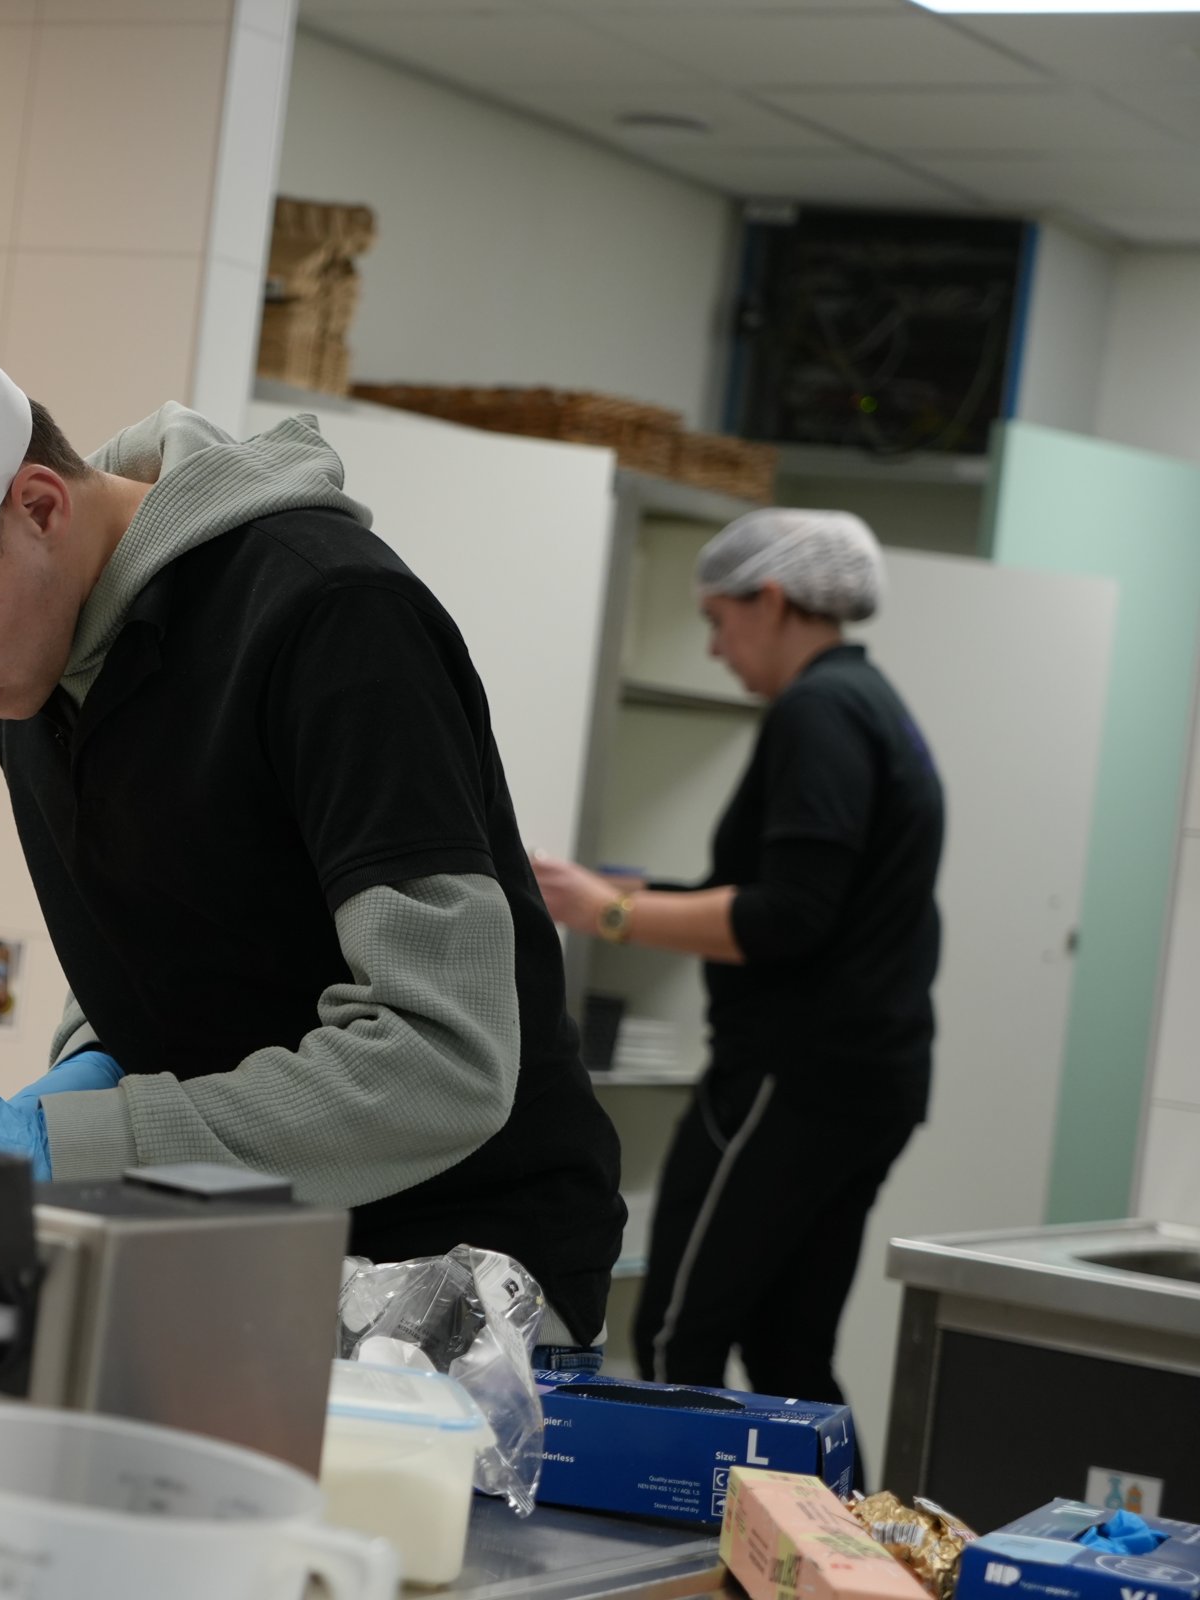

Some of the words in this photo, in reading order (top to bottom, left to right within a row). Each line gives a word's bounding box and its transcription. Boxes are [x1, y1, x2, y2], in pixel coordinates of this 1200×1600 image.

[746, 1428, 769, 1466] L
[715, 1451, 737, 1462] Size:
[648, 1474, 667, 1484] Quality
